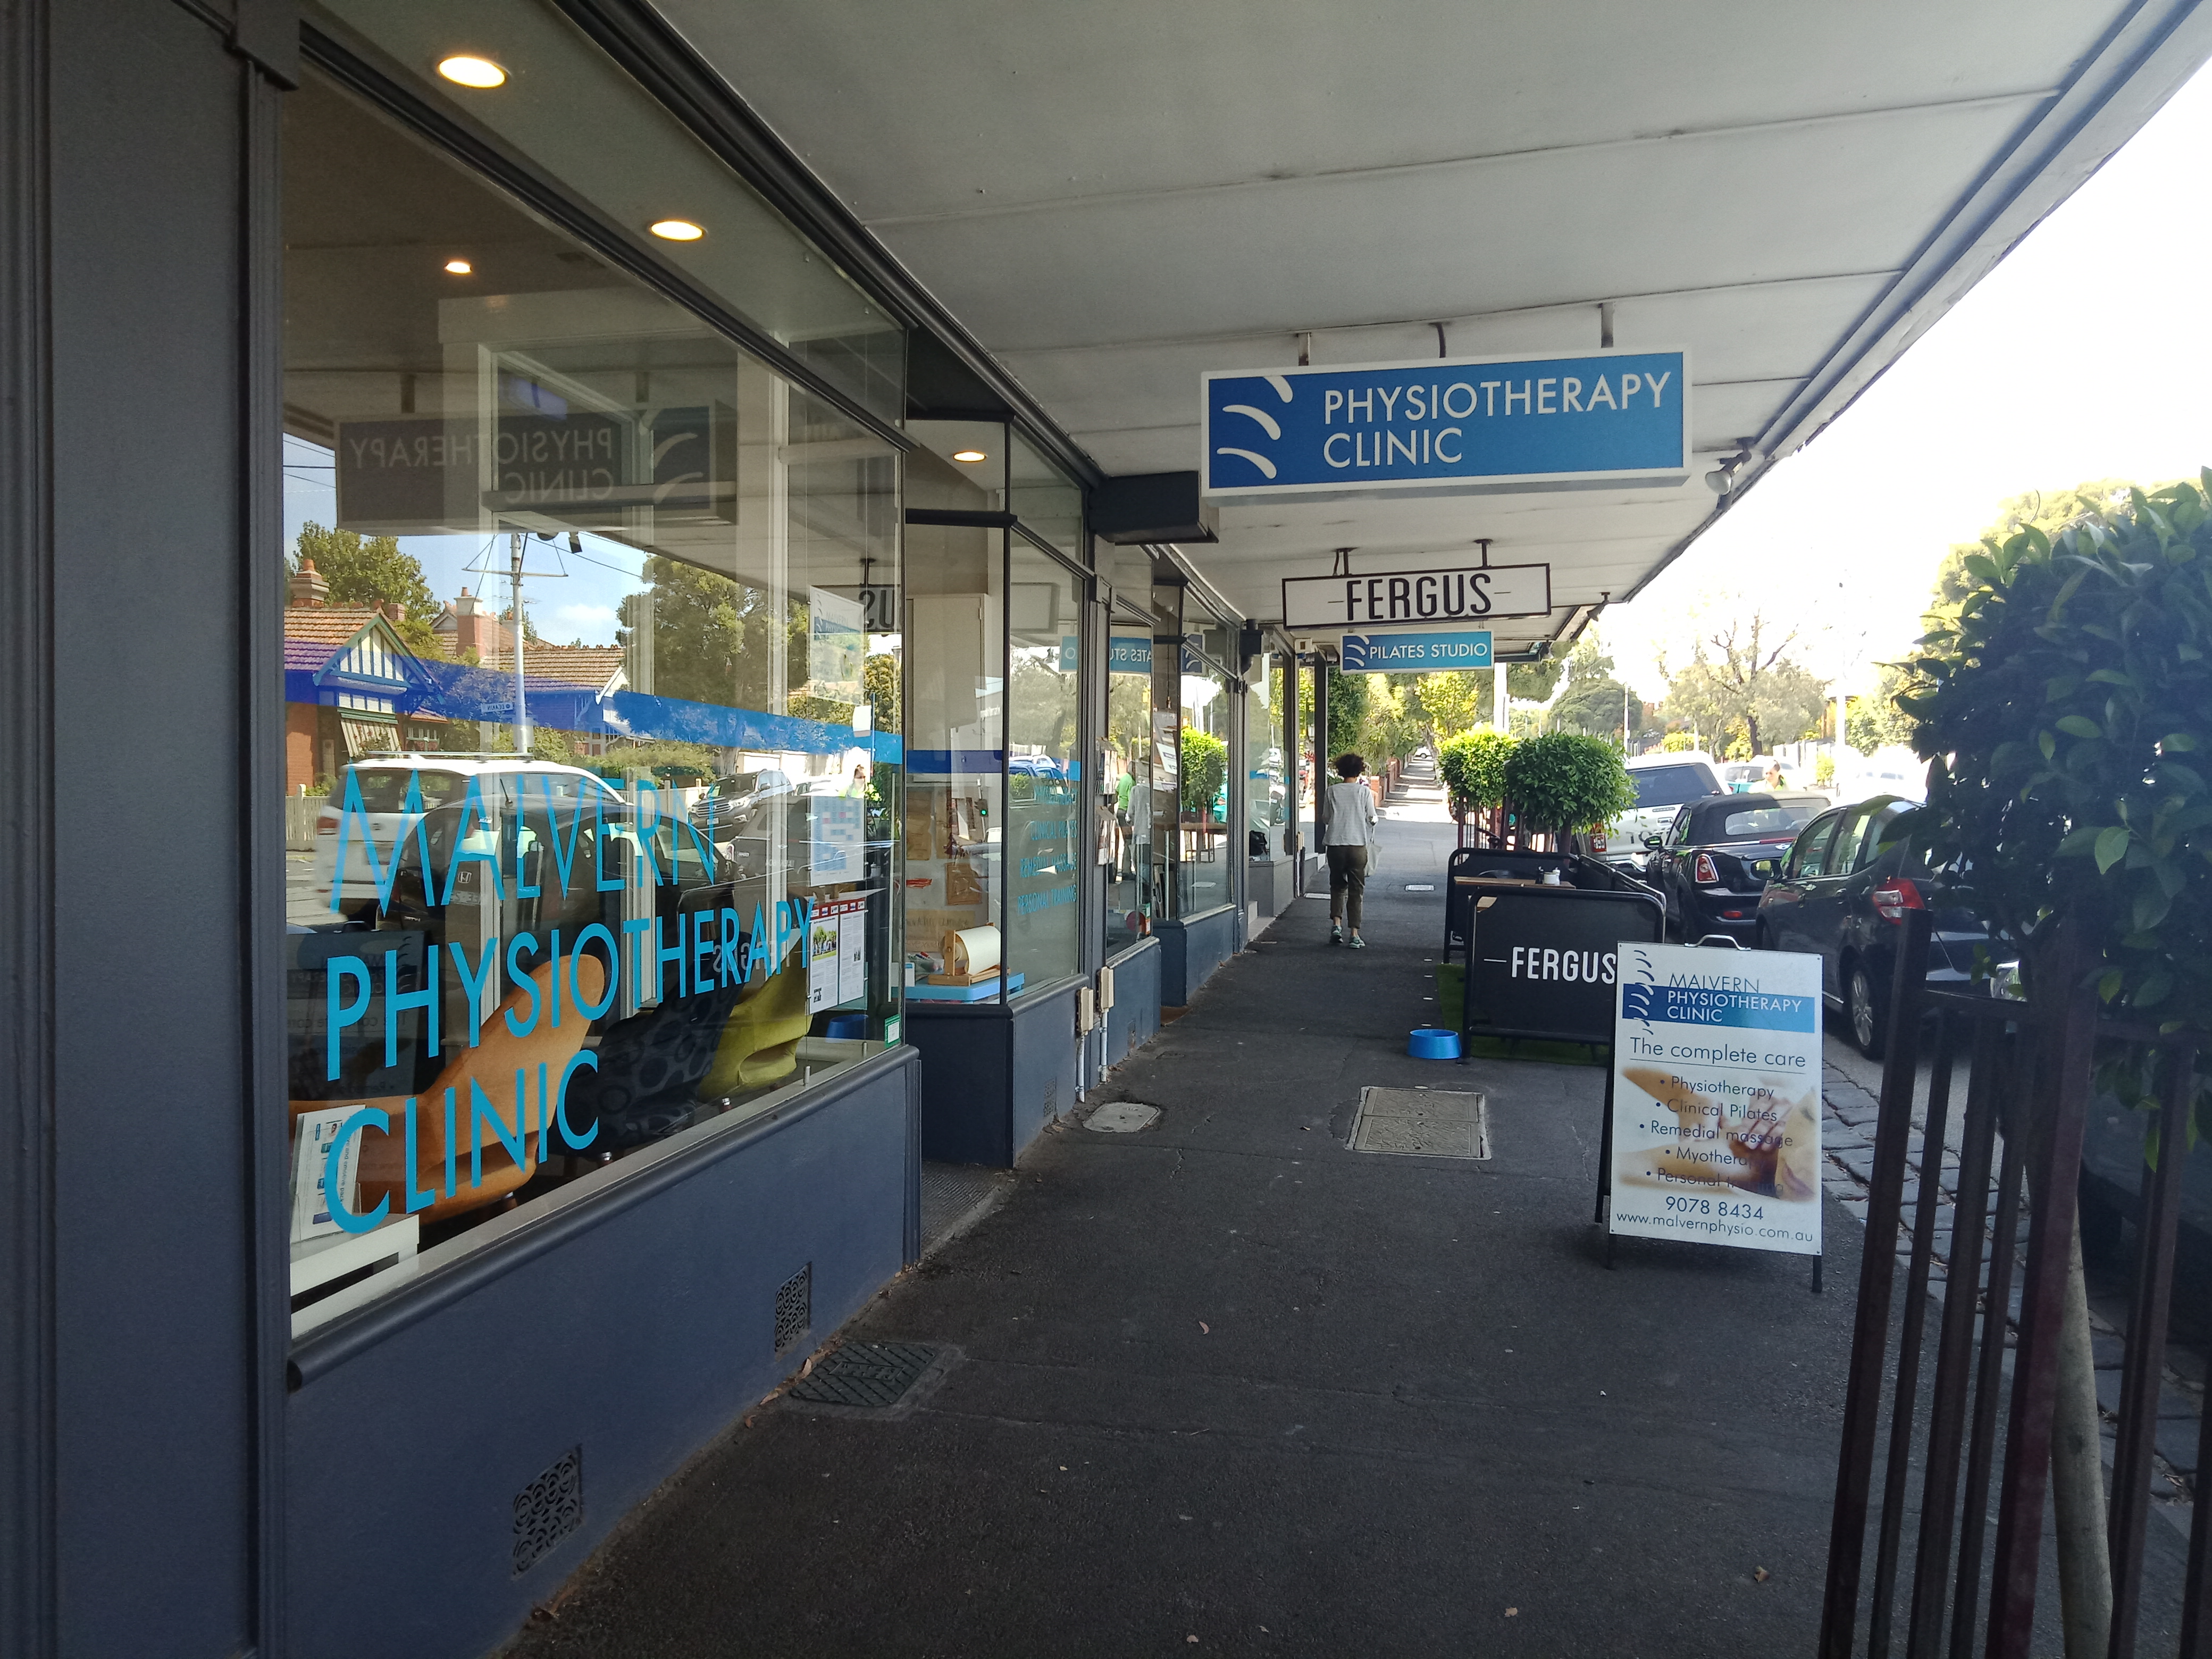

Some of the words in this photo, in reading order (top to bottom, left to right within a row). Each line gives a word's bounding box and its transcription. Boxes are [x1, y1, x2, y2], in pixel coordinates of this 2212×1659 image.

[1324, 371, 1672, 425] PHYSIOTHERAPY
[1323, 427, 1463, 468] CLINIC
[1346, 573, 1492, 621] FERGUS
[1370, 644, 1425, 659] PILATES
[1430, 642, 1488, 658] STUDIO
[330, 760, 715, 917] MALVERN
[1018, 891, 1050, 915] PERSONAL
[1051, 884, 1077, 907] TRAINING
[1511, 947, 1616, 984] FERGUS
[326, 896, 815, 1081] PHYSIOTHERAPY
[1669, 973, 1759, 994] MALVERN
[1667, 1006, 1723, 1023] CLINIC
[1668, 990, 1802, 1013] PHYSIOTHERAPY
[1630, 1036, 1663, 1055] The
[1671, 1044, 1757, 1064] complete
[1764, 1053, 1806, 1067] care
[1671, 1076, 1774, 1100] Physiotherapy
[1667, 1099, 1723, 1117] Clinical
[1730, 1104, 1777, 1121] Pilates
[324, 1049, 598, 1234] CLINIC
[1651, 1120, 1719, 1139] Remedial
[1726, 1132, 1794, 1149] massage
[1676, 1146, 1762, 1170] Myothera
[1657, 1167, 1720, 1187] Personal
[1665, 1196, 1710, 1214] 9078
[1718, 1201, 1764, 1220] 8434
[1616, 1213, 1813, 1242] www.malvernphysio.com.au
